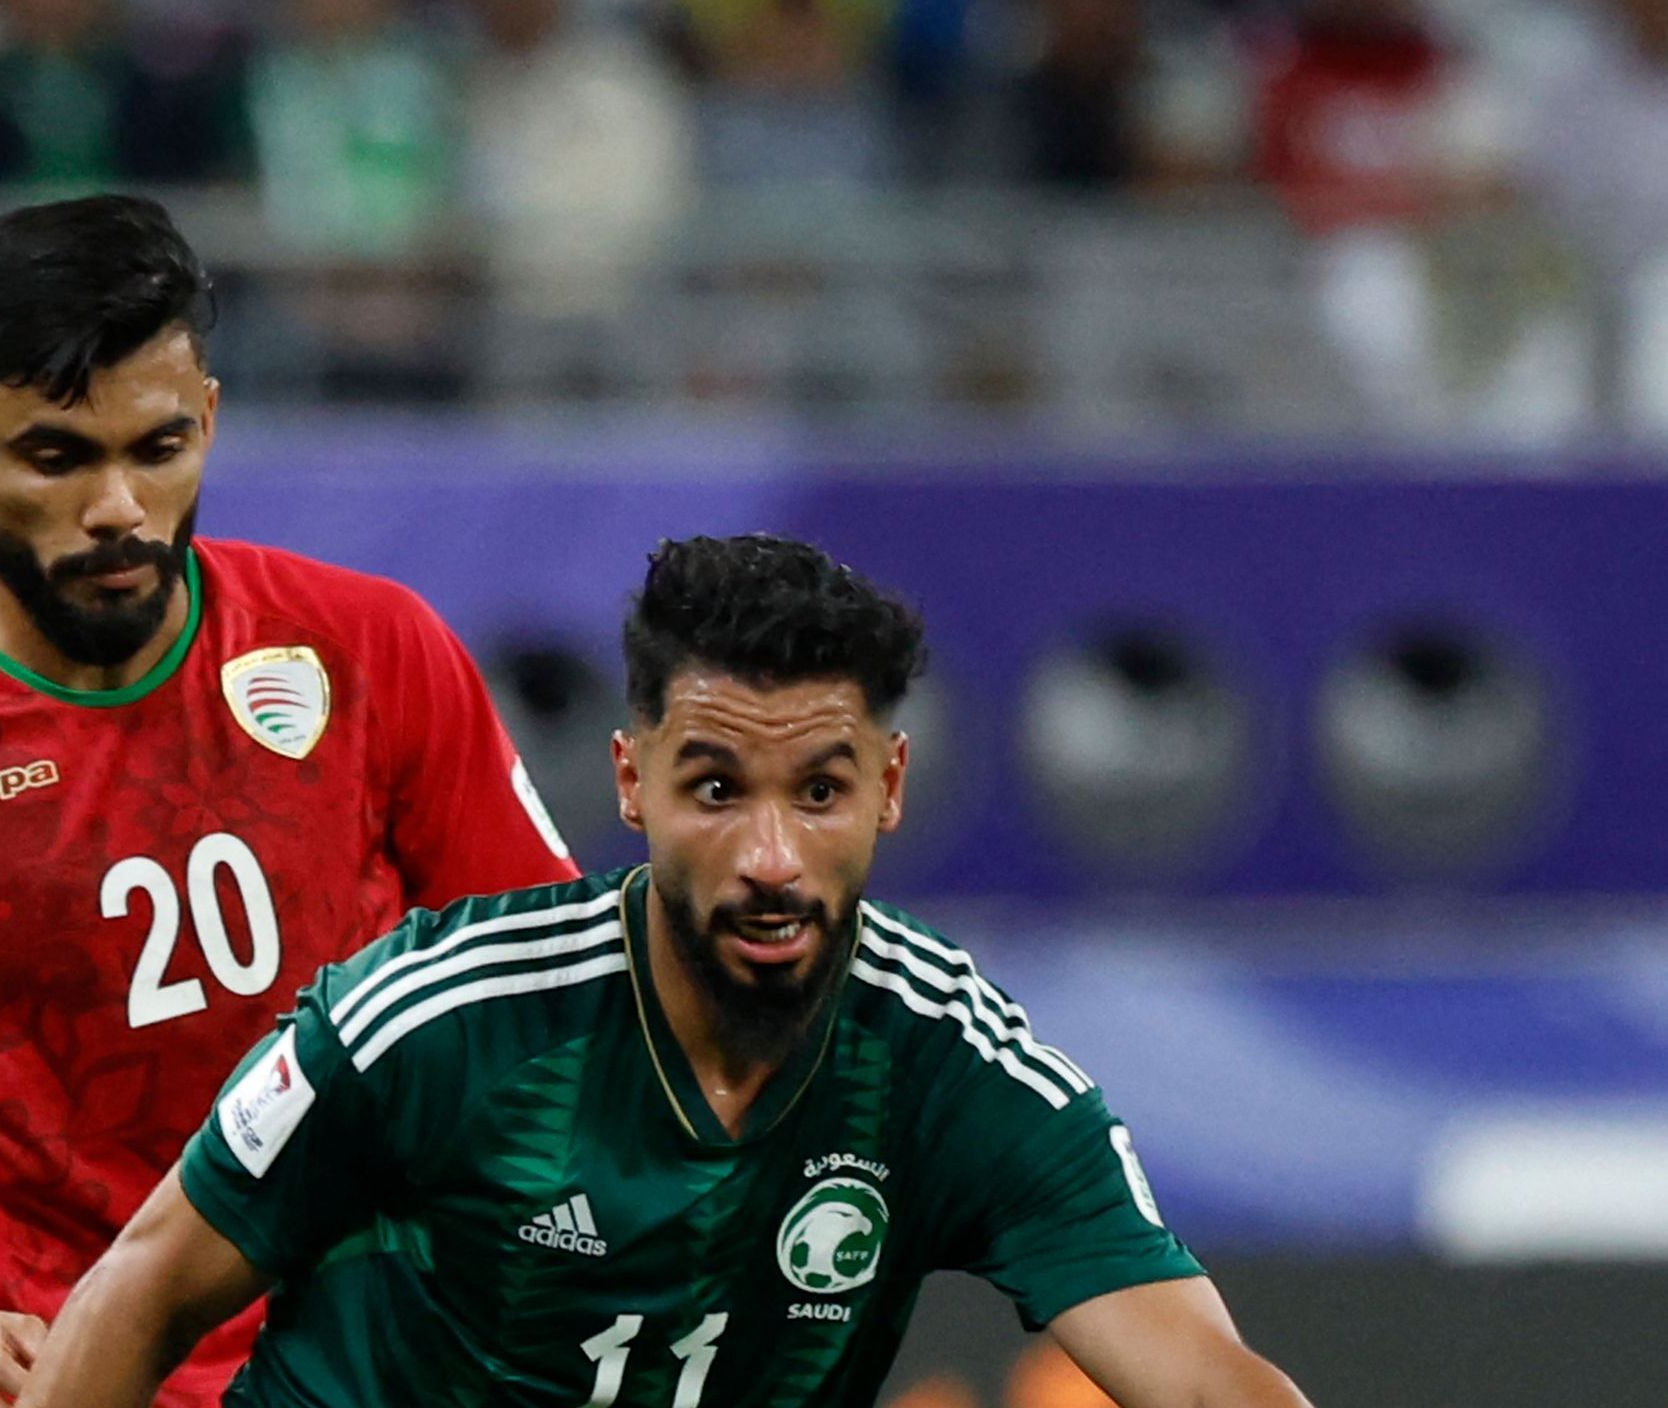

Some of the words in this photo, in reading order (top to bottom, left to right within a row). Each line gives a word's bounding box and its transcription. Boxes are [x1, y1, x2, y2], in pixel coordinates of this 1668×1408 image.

[99, 832, 281, 1029] 20
[803, 1152, 891, 1182] السعودية
[517, 1223, 608, 1257] adidas
[786, 1303, 852, 1323] SAUDI
